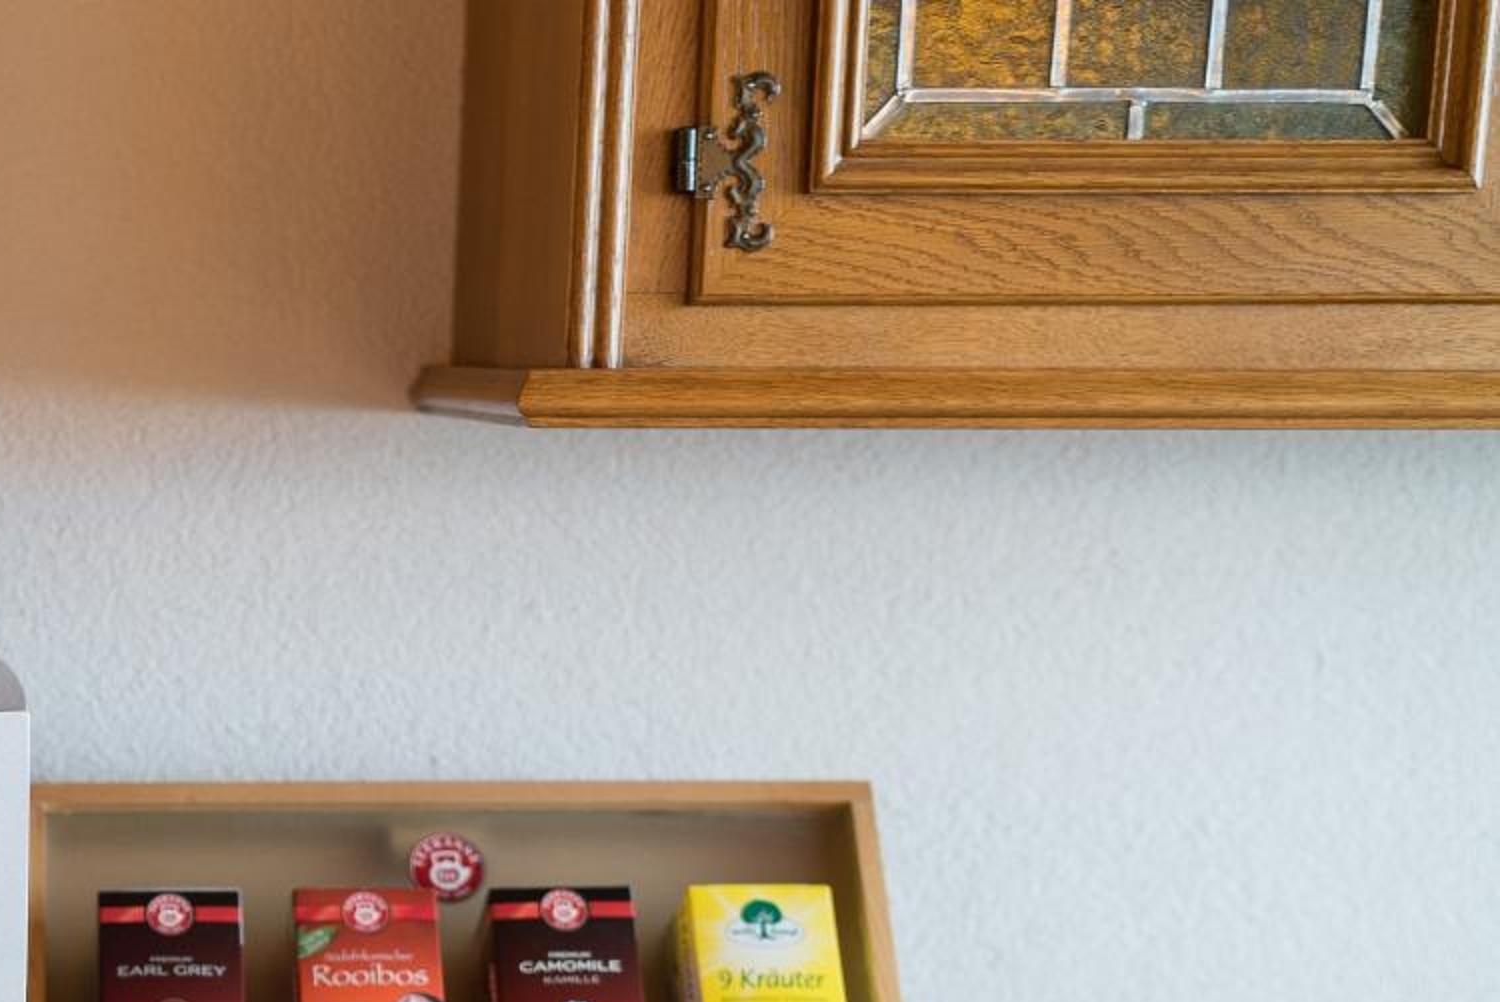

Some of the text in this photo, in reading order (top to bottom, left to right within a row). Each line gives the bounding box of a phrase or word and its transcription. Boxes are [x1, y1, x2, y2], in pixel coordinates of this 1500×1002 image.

[117, 963, 227, 977] EARL GREY
[312, 962, 430, 987] Rooibos
[519, 959, 622, 974] CAMOMILE
[717, 967, 825, 991] 9 Kräuter
